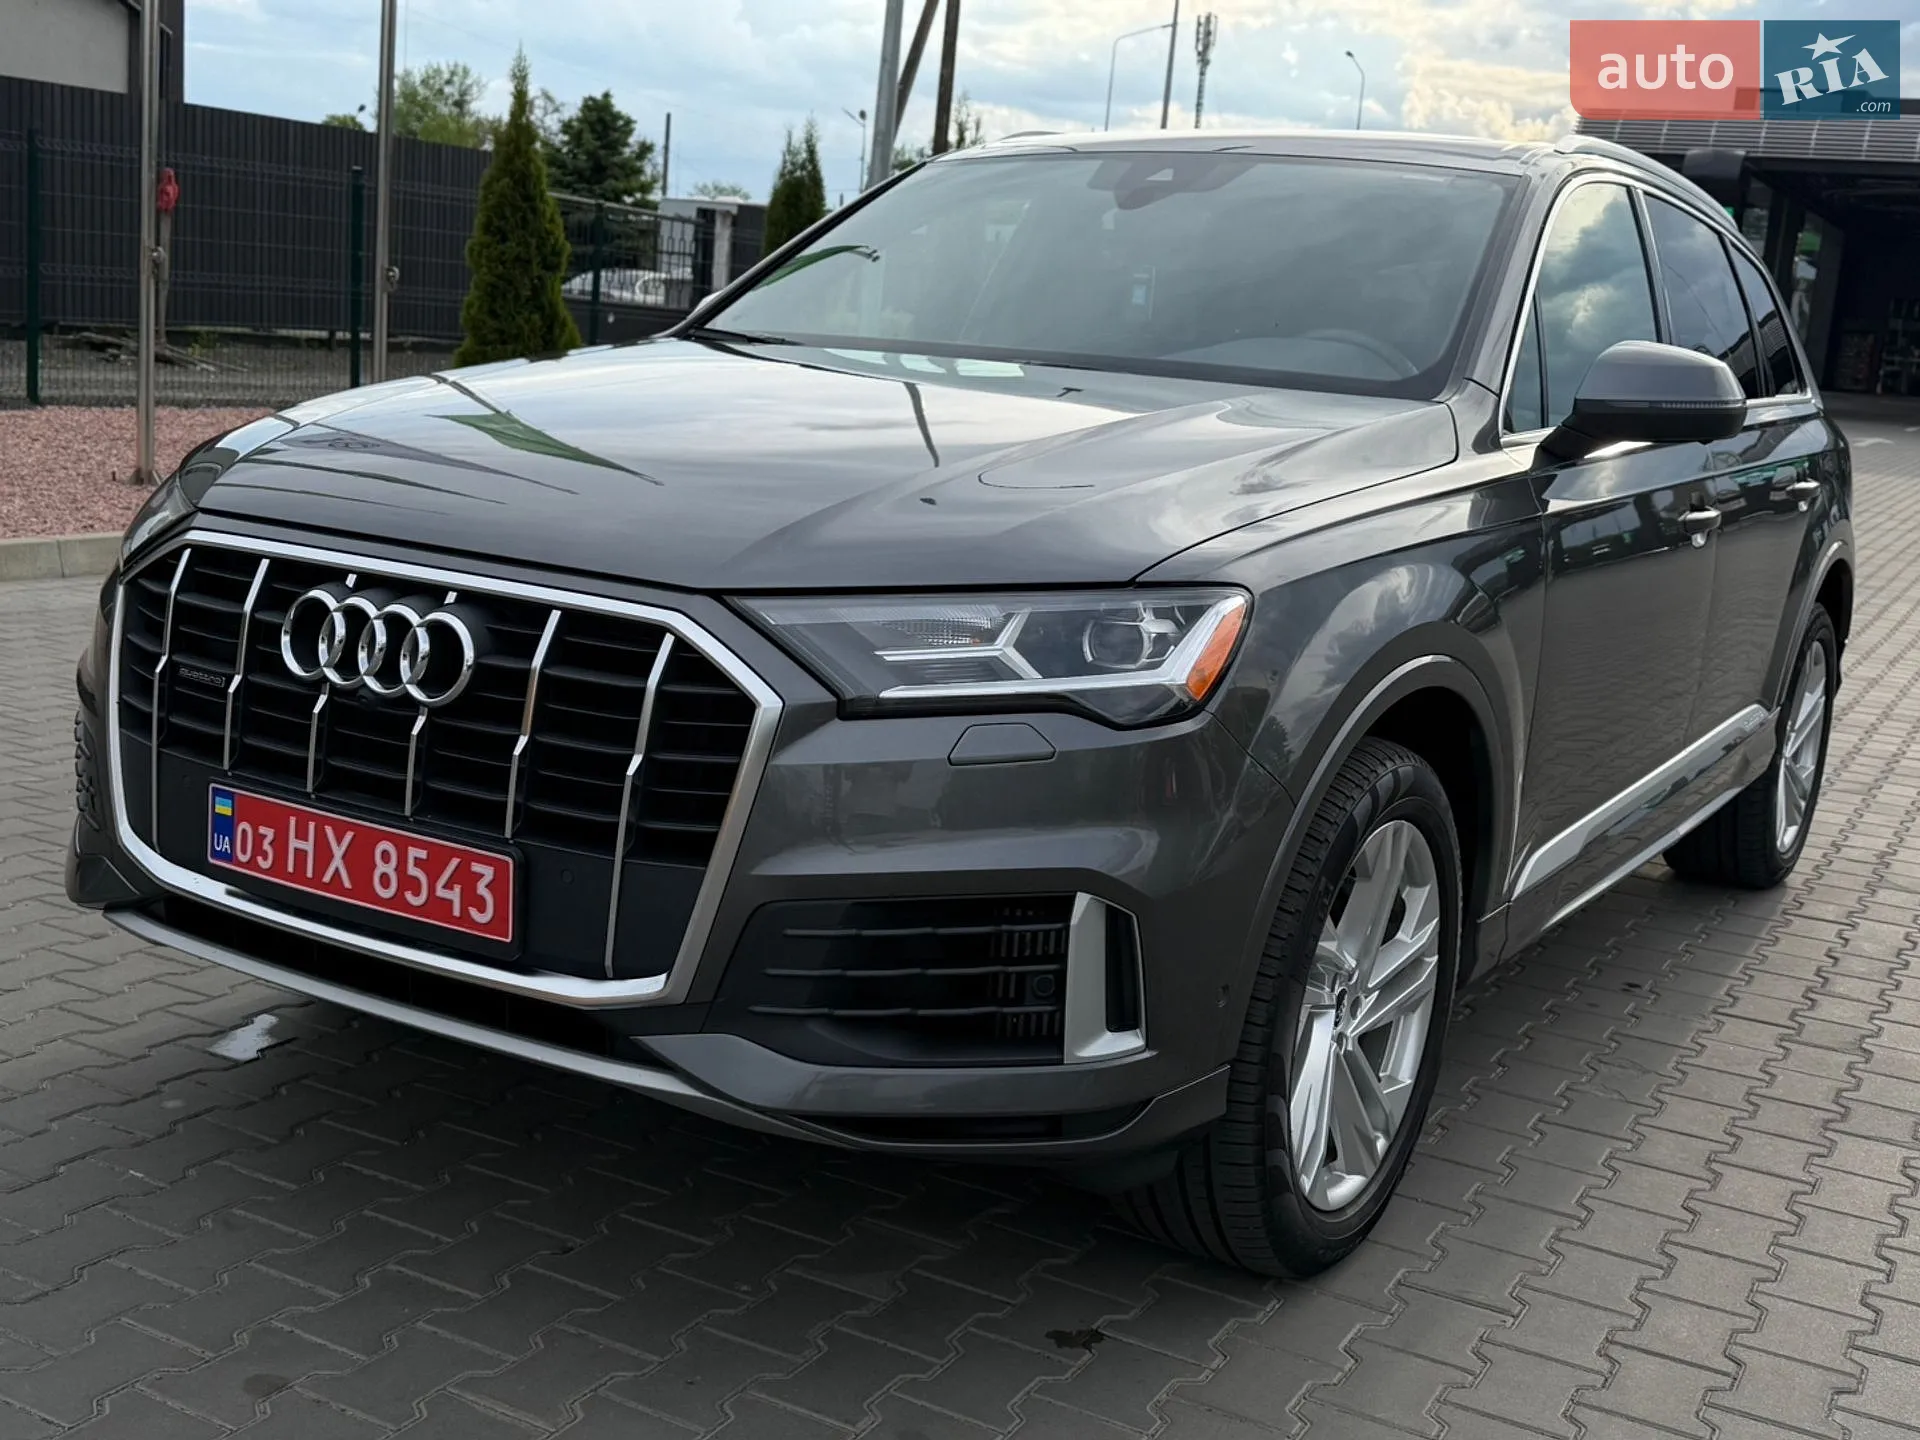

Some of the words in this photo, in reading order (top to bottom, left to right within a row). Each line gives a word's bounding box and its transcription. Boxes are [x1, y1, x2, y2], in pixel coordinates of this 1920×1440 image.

[213, 832, 231, 854] UA
[235, 821, 276, 870] 03
[286, 815, 356, 890] HX
[372, 839, 496, 925] 8543
